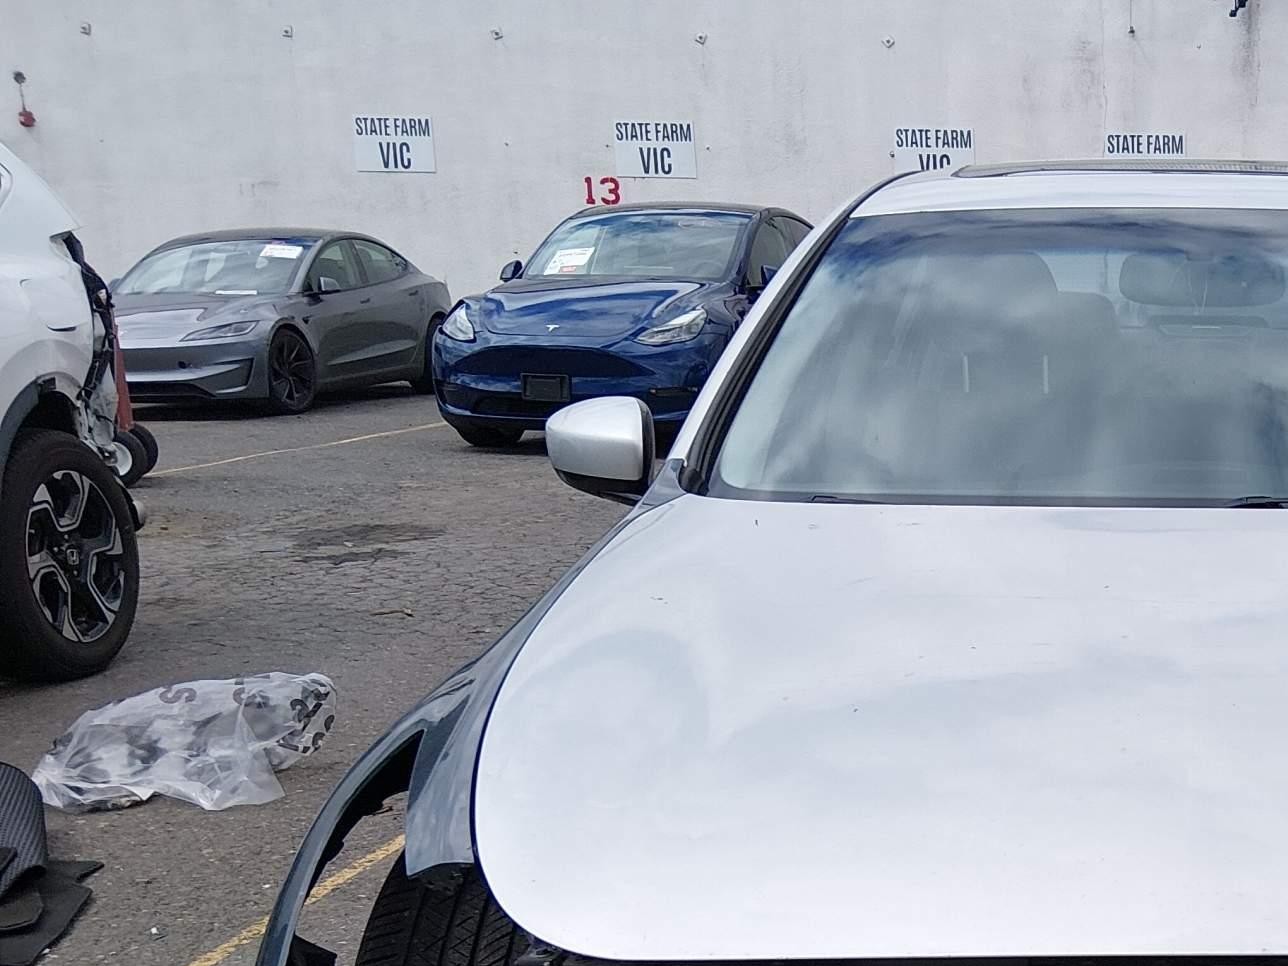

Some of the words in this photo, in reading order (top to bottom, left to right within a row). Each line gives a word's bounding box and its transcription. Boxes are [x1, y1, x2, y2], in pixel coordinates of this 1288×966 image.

[355, 117, 391, 136] STATE
[394, 118, 431, 137] FARM
[615, 122, 652, 141] STATE
[655, 123, 692, 142] FARM
[896, 128, 932, 148] STATE
[935, 129, 972, 149] FARM
[1107, 134, 1143, 154] STATE
[1146, 135, 1184, 154] FARM
[379, 141, 412, 169] VIC
[639, 146, 673, 175] VIC
[584, 176, 621, 206] 13
